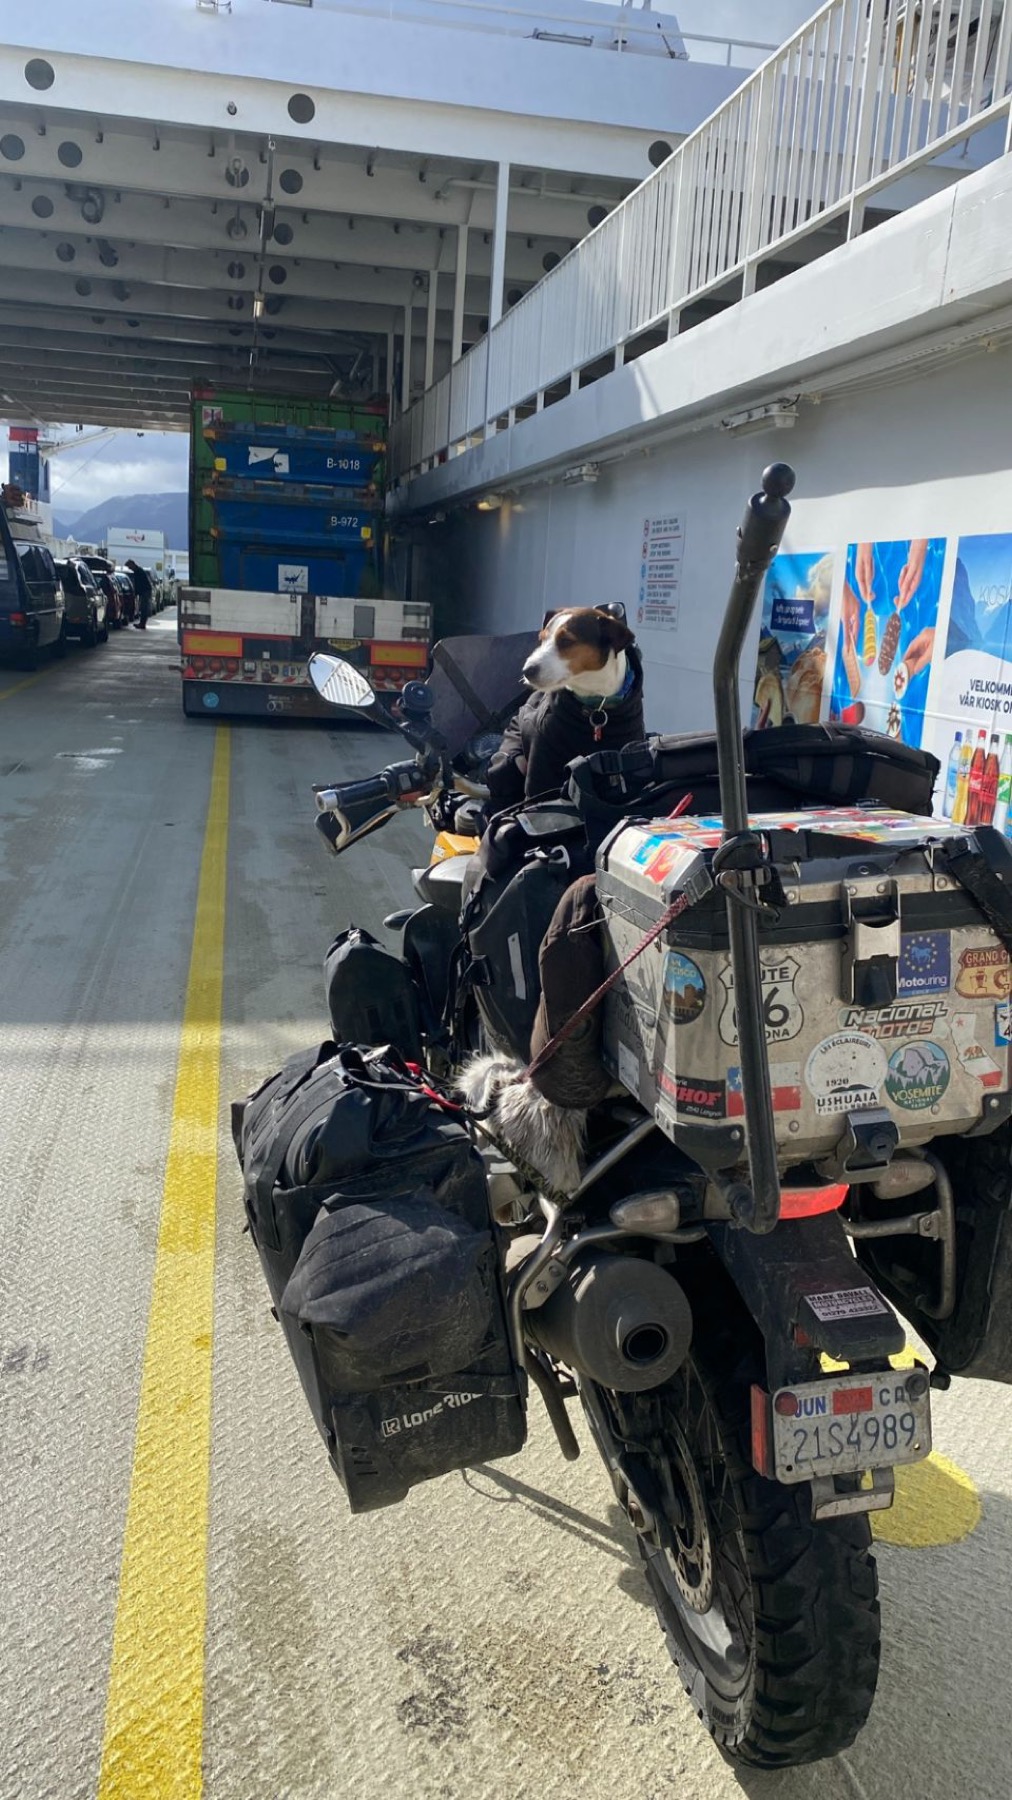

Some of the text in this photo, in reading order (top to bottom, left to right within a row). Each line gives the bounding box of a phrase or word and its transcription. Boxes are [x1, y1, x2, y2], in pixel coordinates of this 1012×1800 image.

[326, 457, 360, 471] B-1018
[330, 516, 358, 528] B-972
[959, 690, 974, 708] VÅR
[976, 695, 1001, 713] KIOSK
[965, 951, 998, 963] GRAND
[730, 966, 790, 986] UTE
[733, 986, 790, 1028] 6
[817, 1091, 878, 1108] USHUAIA
[892, 1085, 943, 1101] YOSEMITE
[794, 1395, 827, 1418] JUN
[793, 1412, 917, 1464] 21S4989
